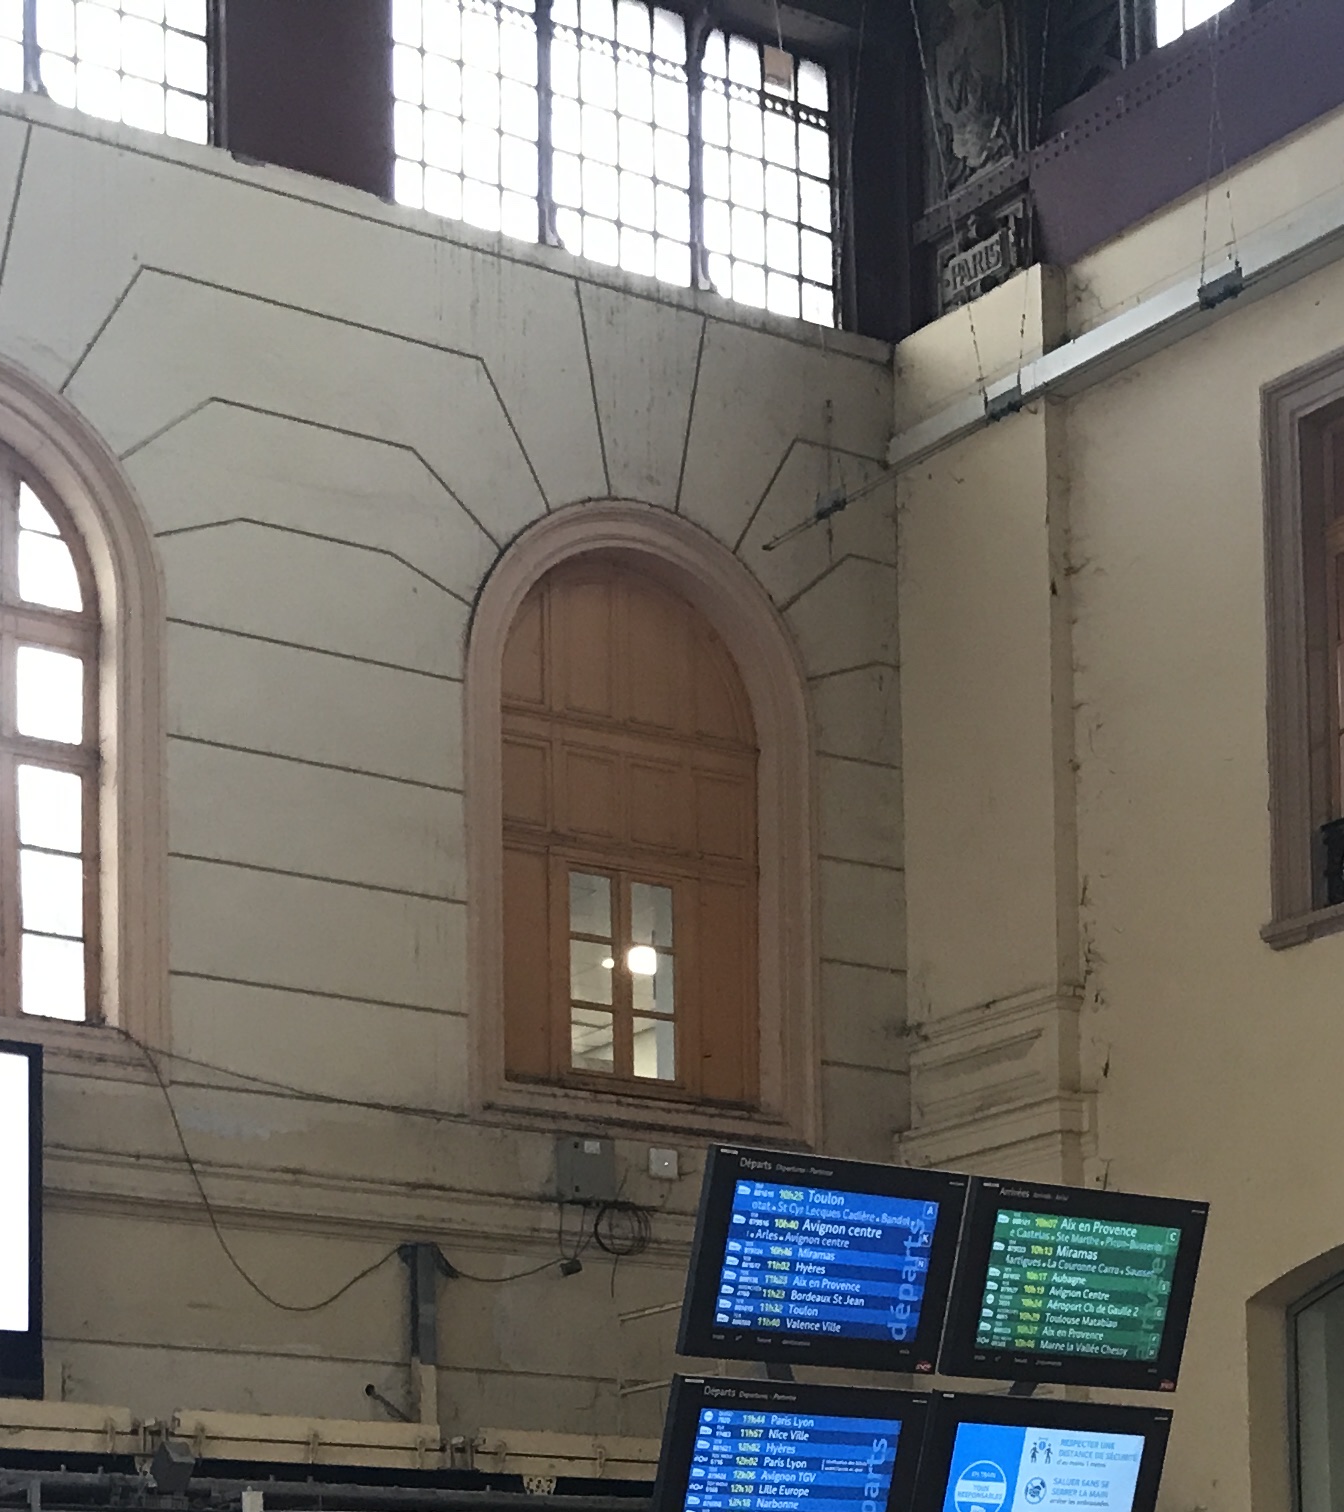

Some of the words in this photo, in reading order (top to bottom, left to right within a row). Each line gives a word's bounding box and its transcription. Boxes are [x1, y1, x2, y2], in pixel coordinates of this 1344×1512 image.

[951, 238, 1002, 290] PARIS
[739, 1156, 773, 1171] Départs
[808, 1190, 845, 1206] Toulon
[802, 1218, 847, 1237] Avignon
[847, 1222, 883, 1239] centre
[1059, 1218, 1077, 1231] Aix
[1078, 1221, 1091, 1232] en
[1092, 1221, 1138, 1238] Provence
[756, 1228, 779, 1242] Arles
[784, 1231, 815, 1247] Avignon
[816, 1236, 850, 1249] centre
[797, 1248, 836, 1262] Miramas
[1056, 1246, 1099, 1261] Miramas
[794, 1261, 826, 1275] Hyères
[1046, 1258, 1057, 1268] La
[1058, 1260, 1097, 1273] Couronne
[792, 1276, 807, 1288] Aix
[808, 1279, 820, 1289] en
[821, 1278, 861, 1293] Provence
[887, 1218, 925, 1341] départs
[1051, 1273, 1087, 1287] Aubagne
[790, 1289, 832, 1305] Bordeaux
[832, 1293, 844, 1305] St
[844, 1294, 866, 1307] Jean
[1048, 1286, 1082, 1300] Avignon
[1082, 1289, 1110, 1301] Centre
[788, 1304, 819, 1317] Toulon
[1046, 1300, 1083, 1314] Aéroport
[1095, 1303, 1106, 1314] de
[1107, 1304, 1133, 1317] Gaulle
[786, 1317, 821, 1332] Valence
[821, 1320, 842, 1333] Ville
[1045, 1313, 1081, 1327] Toulouse
[1041, 1325, 1055, 1337] Aix
[1056, 1328, 1067, 1338] en
[1068, 1328, 1104, 1341] Provence
[1040, 1340, 1065, 1352] Marne
[703, 1385, 736, 1398] Départs
[770, 1415, 792, 1427] Paris
[792, 1416, 815, 1429] Lyon
[768, 1428, 789, 1440] Nice
[789, 1430, 810, 1442] Ville
[765, 1442, 796, 1455] Hyères
[1058, 1449, 1093, 1459] DISTANCE
[763, 1456, 785, 1468] Paris
[784, 1458, 807, 1470] Lyon
[760, 1470, 797, 1484] Avignon
[797, 1472, 817, 1484] TGV
[1053, 1477, 1081, 1487] SALUER
[758, 1483, 778, 1496] Lille
[779, 1485, 810, 1498] Europe
[1079, 1489, 1088, 1497] LA
[756, 1497, 799, 1510] Narbonne
